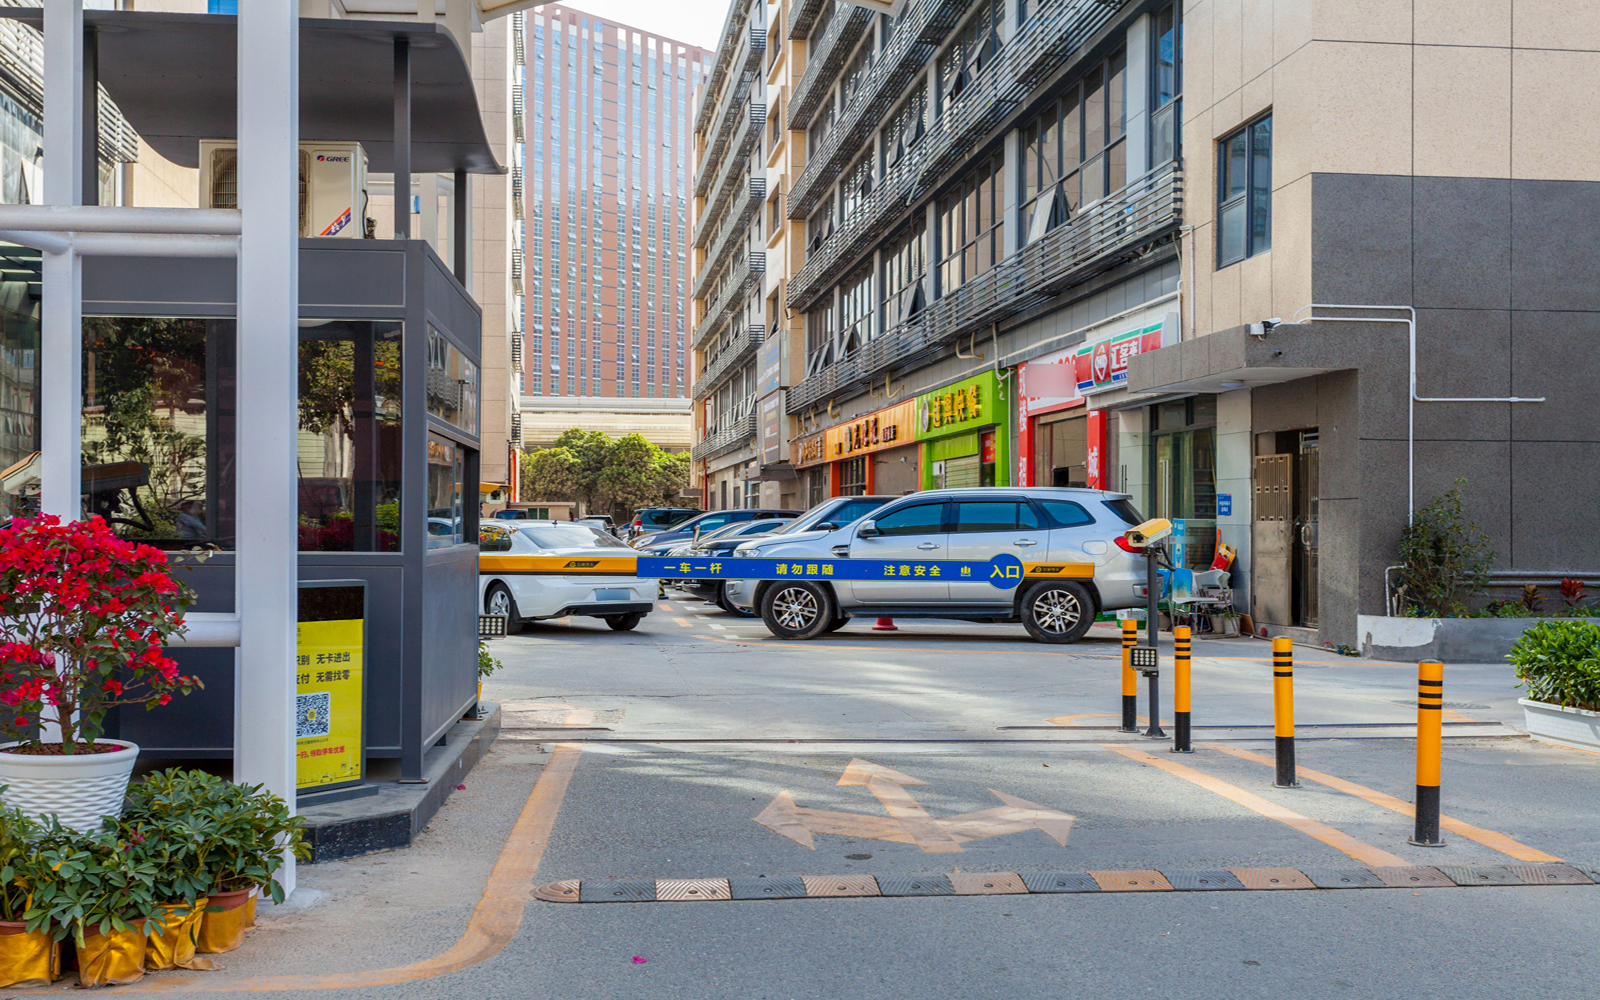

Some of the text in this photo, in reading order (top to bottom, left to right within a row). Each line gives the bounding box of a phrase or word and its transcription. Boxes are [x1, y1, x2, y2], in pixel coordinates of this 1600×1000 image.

[664, 562, 1019, 578] 一车一杆 请勿跟随 注意安全 入口
[316, 651, 350, 665] 无卡进出
[316, 669, 350, 683] 无需找零
